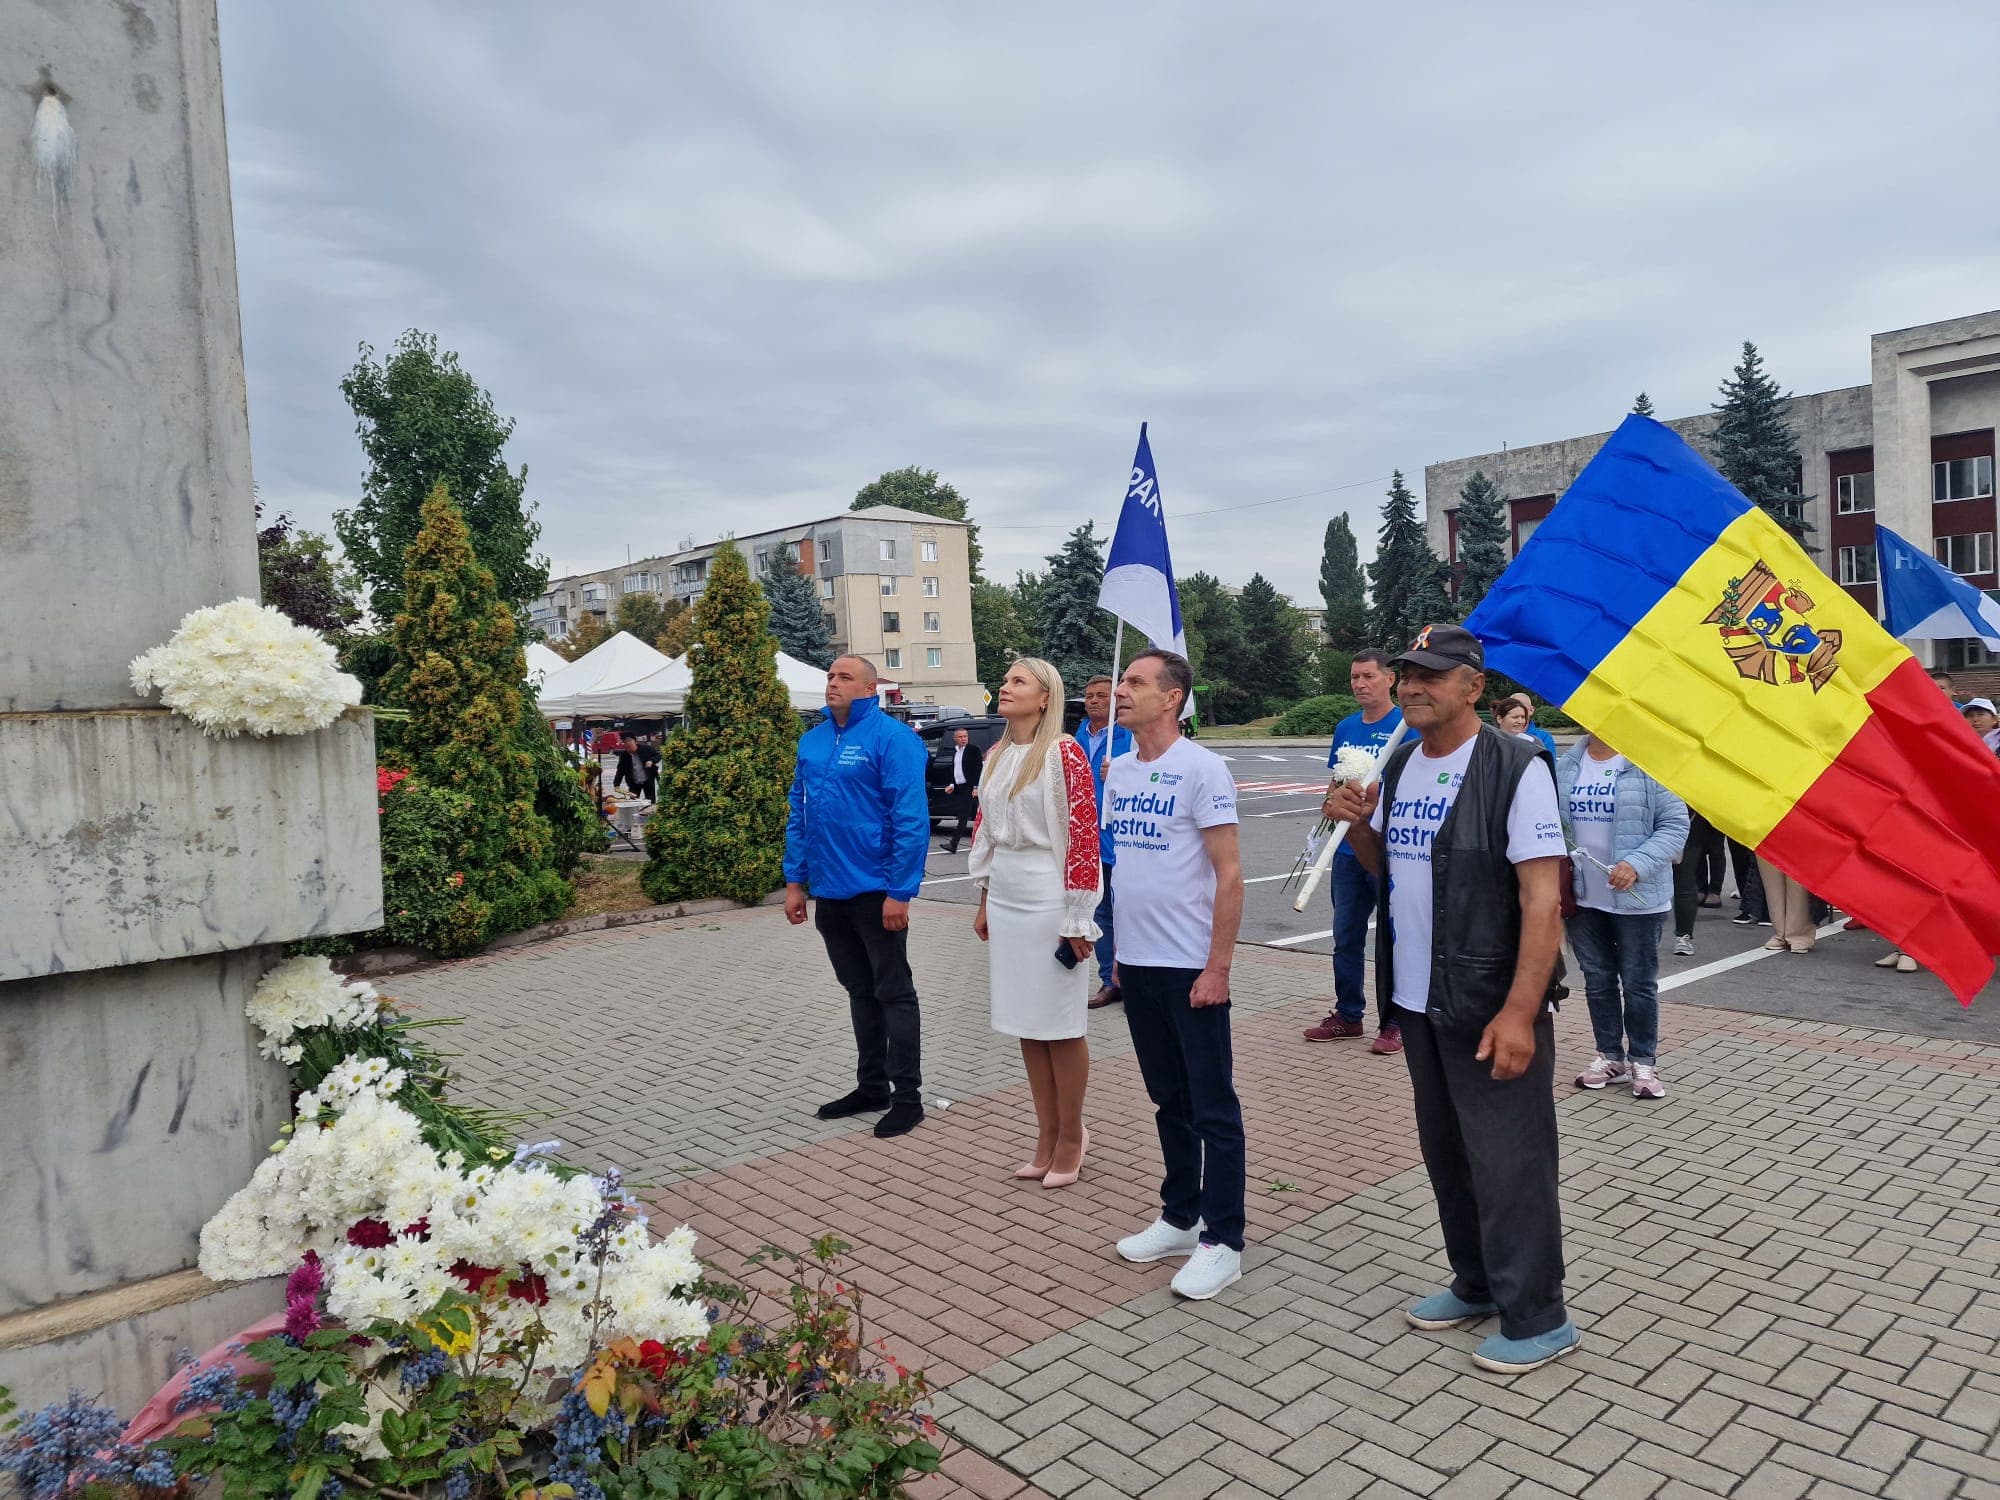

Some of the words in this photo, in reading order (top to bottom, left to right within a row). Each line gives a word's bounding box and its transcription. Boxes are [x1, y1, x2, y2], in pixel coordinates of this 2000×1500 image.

[1390, 795, 1452, 821] artid
[1569, 799, 1615, 814] ostru
[1112, 817, 1162, 838] ostru.
[1385, 825, 1435, 847] ostr
[1114, 840, 1132, 848] entru
[1133, 840, 1170, 851] Moldova!
[1392, 849, 1416, 860] Pentru
[1417, 852, 1431, 862] Mo
